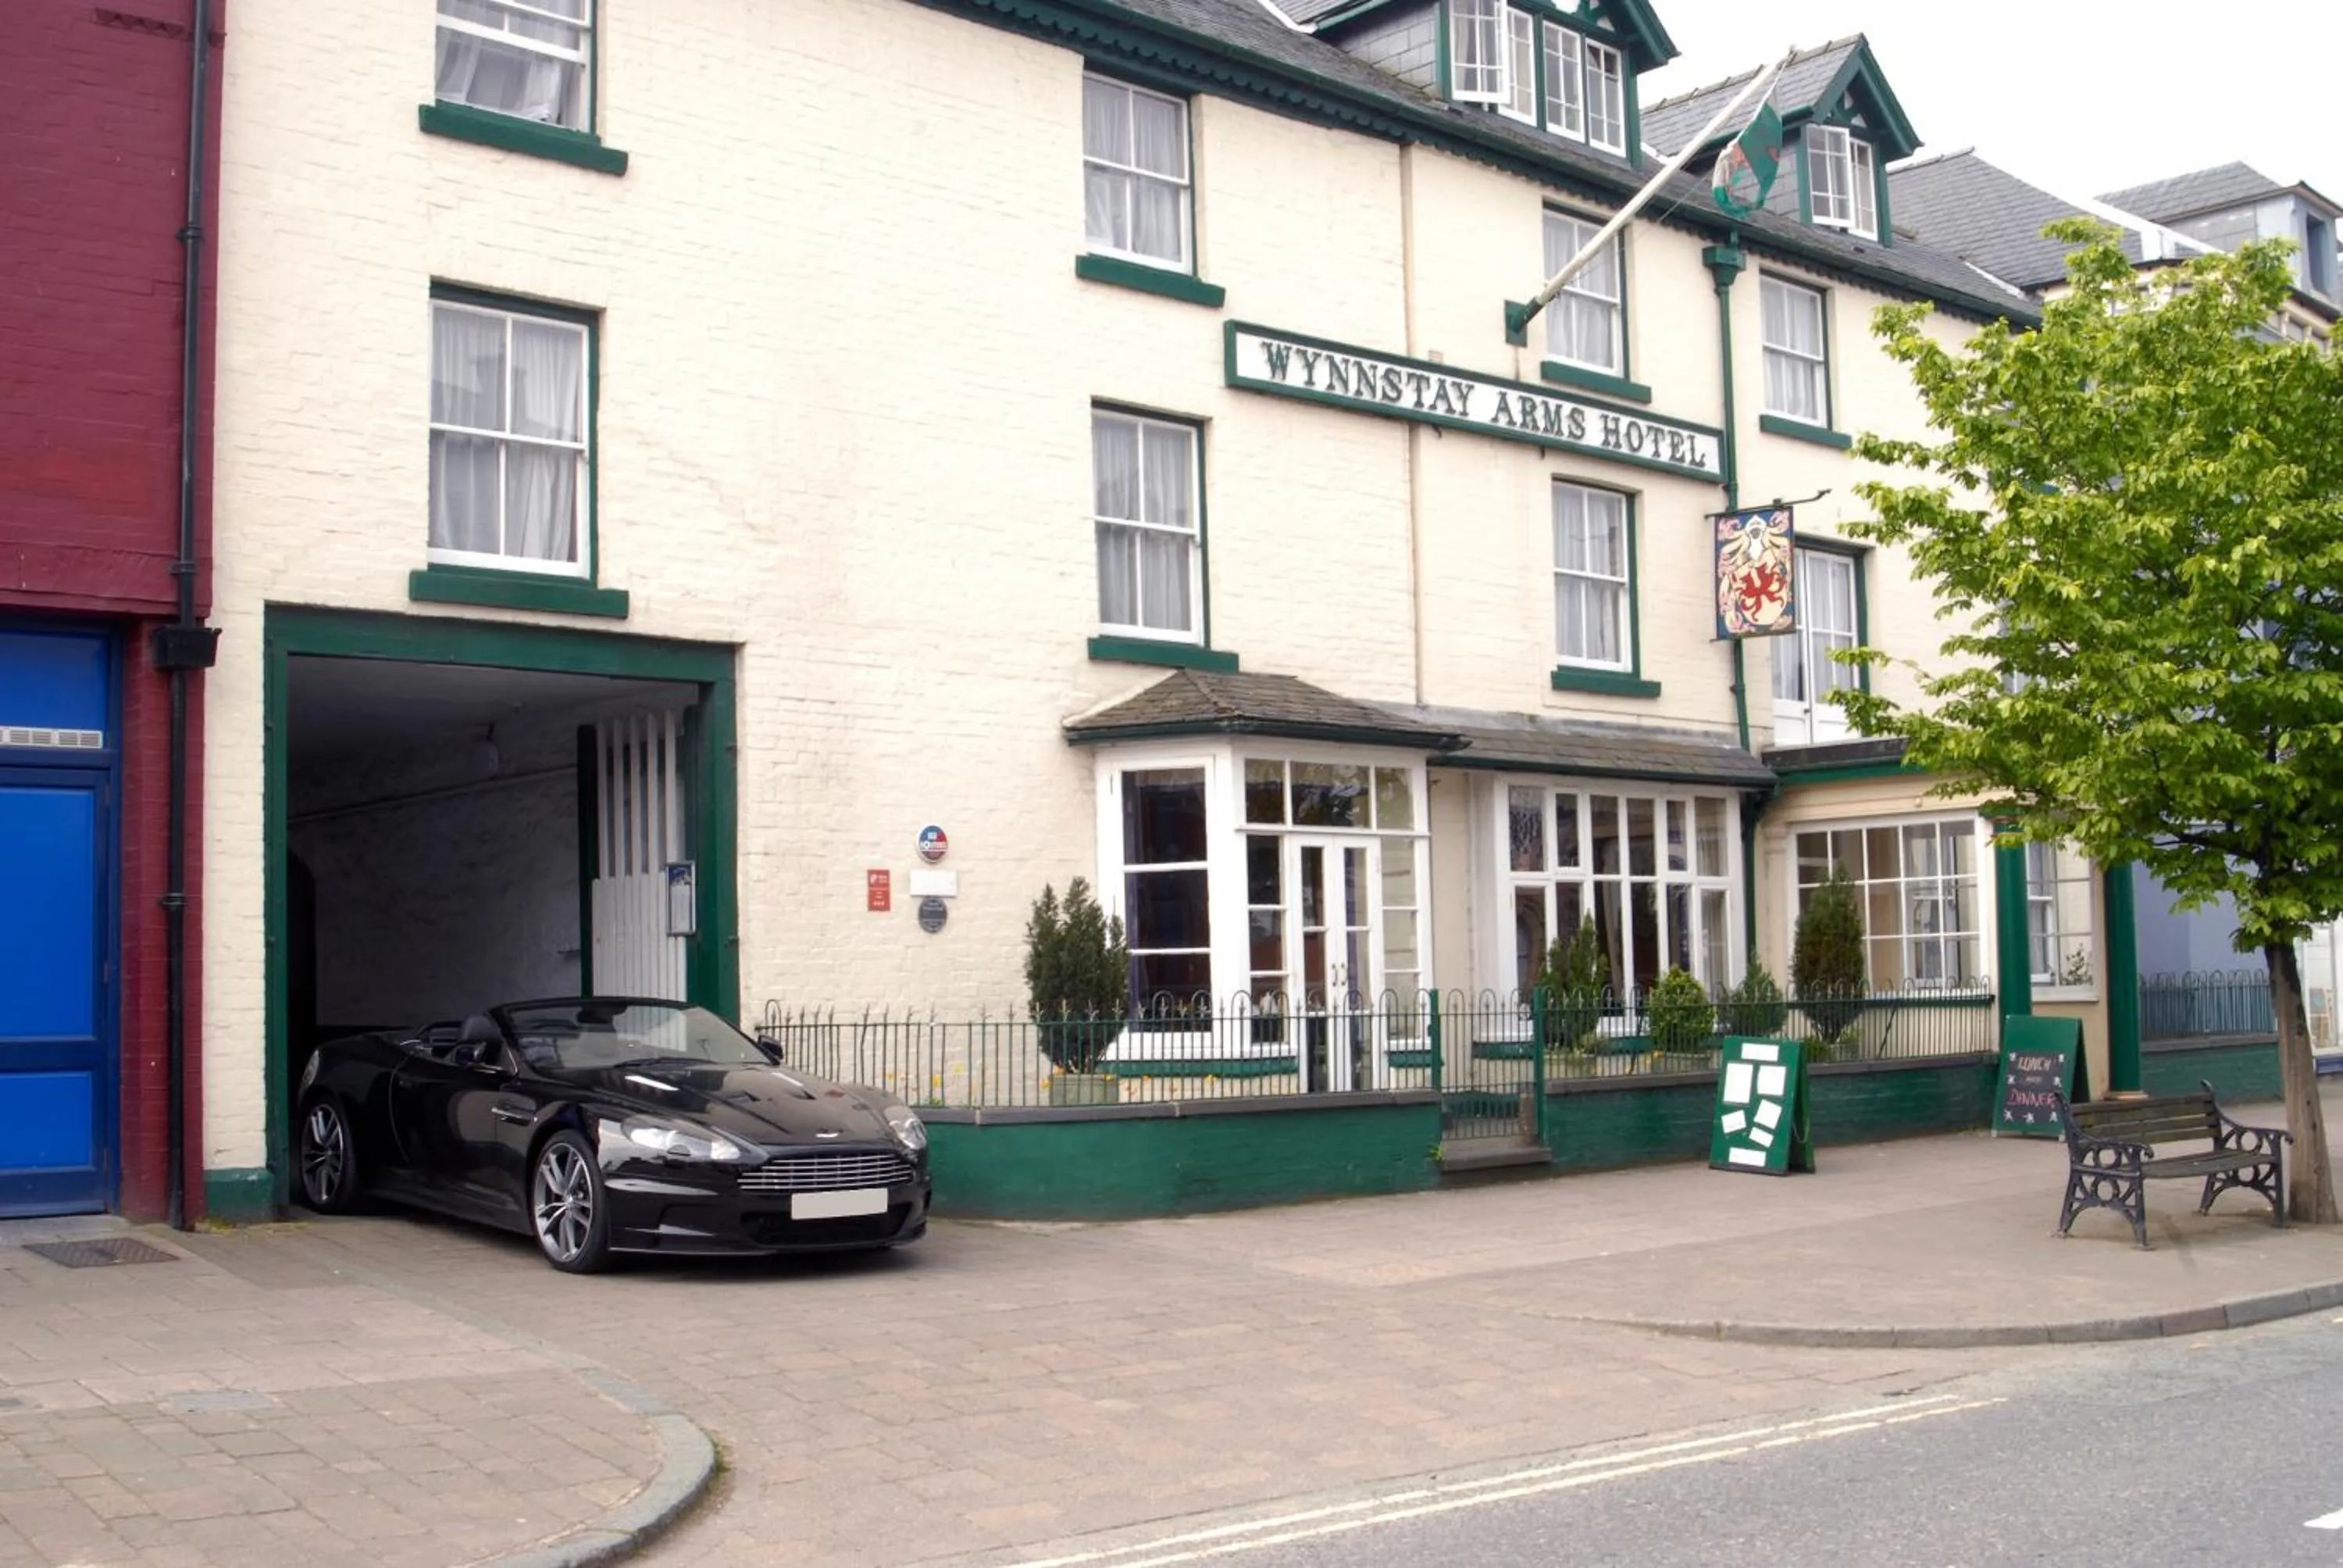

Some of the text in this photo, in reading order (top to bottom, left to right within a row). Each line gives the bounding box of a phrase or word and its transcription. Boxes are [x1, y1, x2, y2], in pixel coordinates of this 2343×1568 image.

[1261, 340, 1706, 468] WYNNSTAY ARMS HOTEL
[2018, 1056, 2052, 1071] LUNCH
